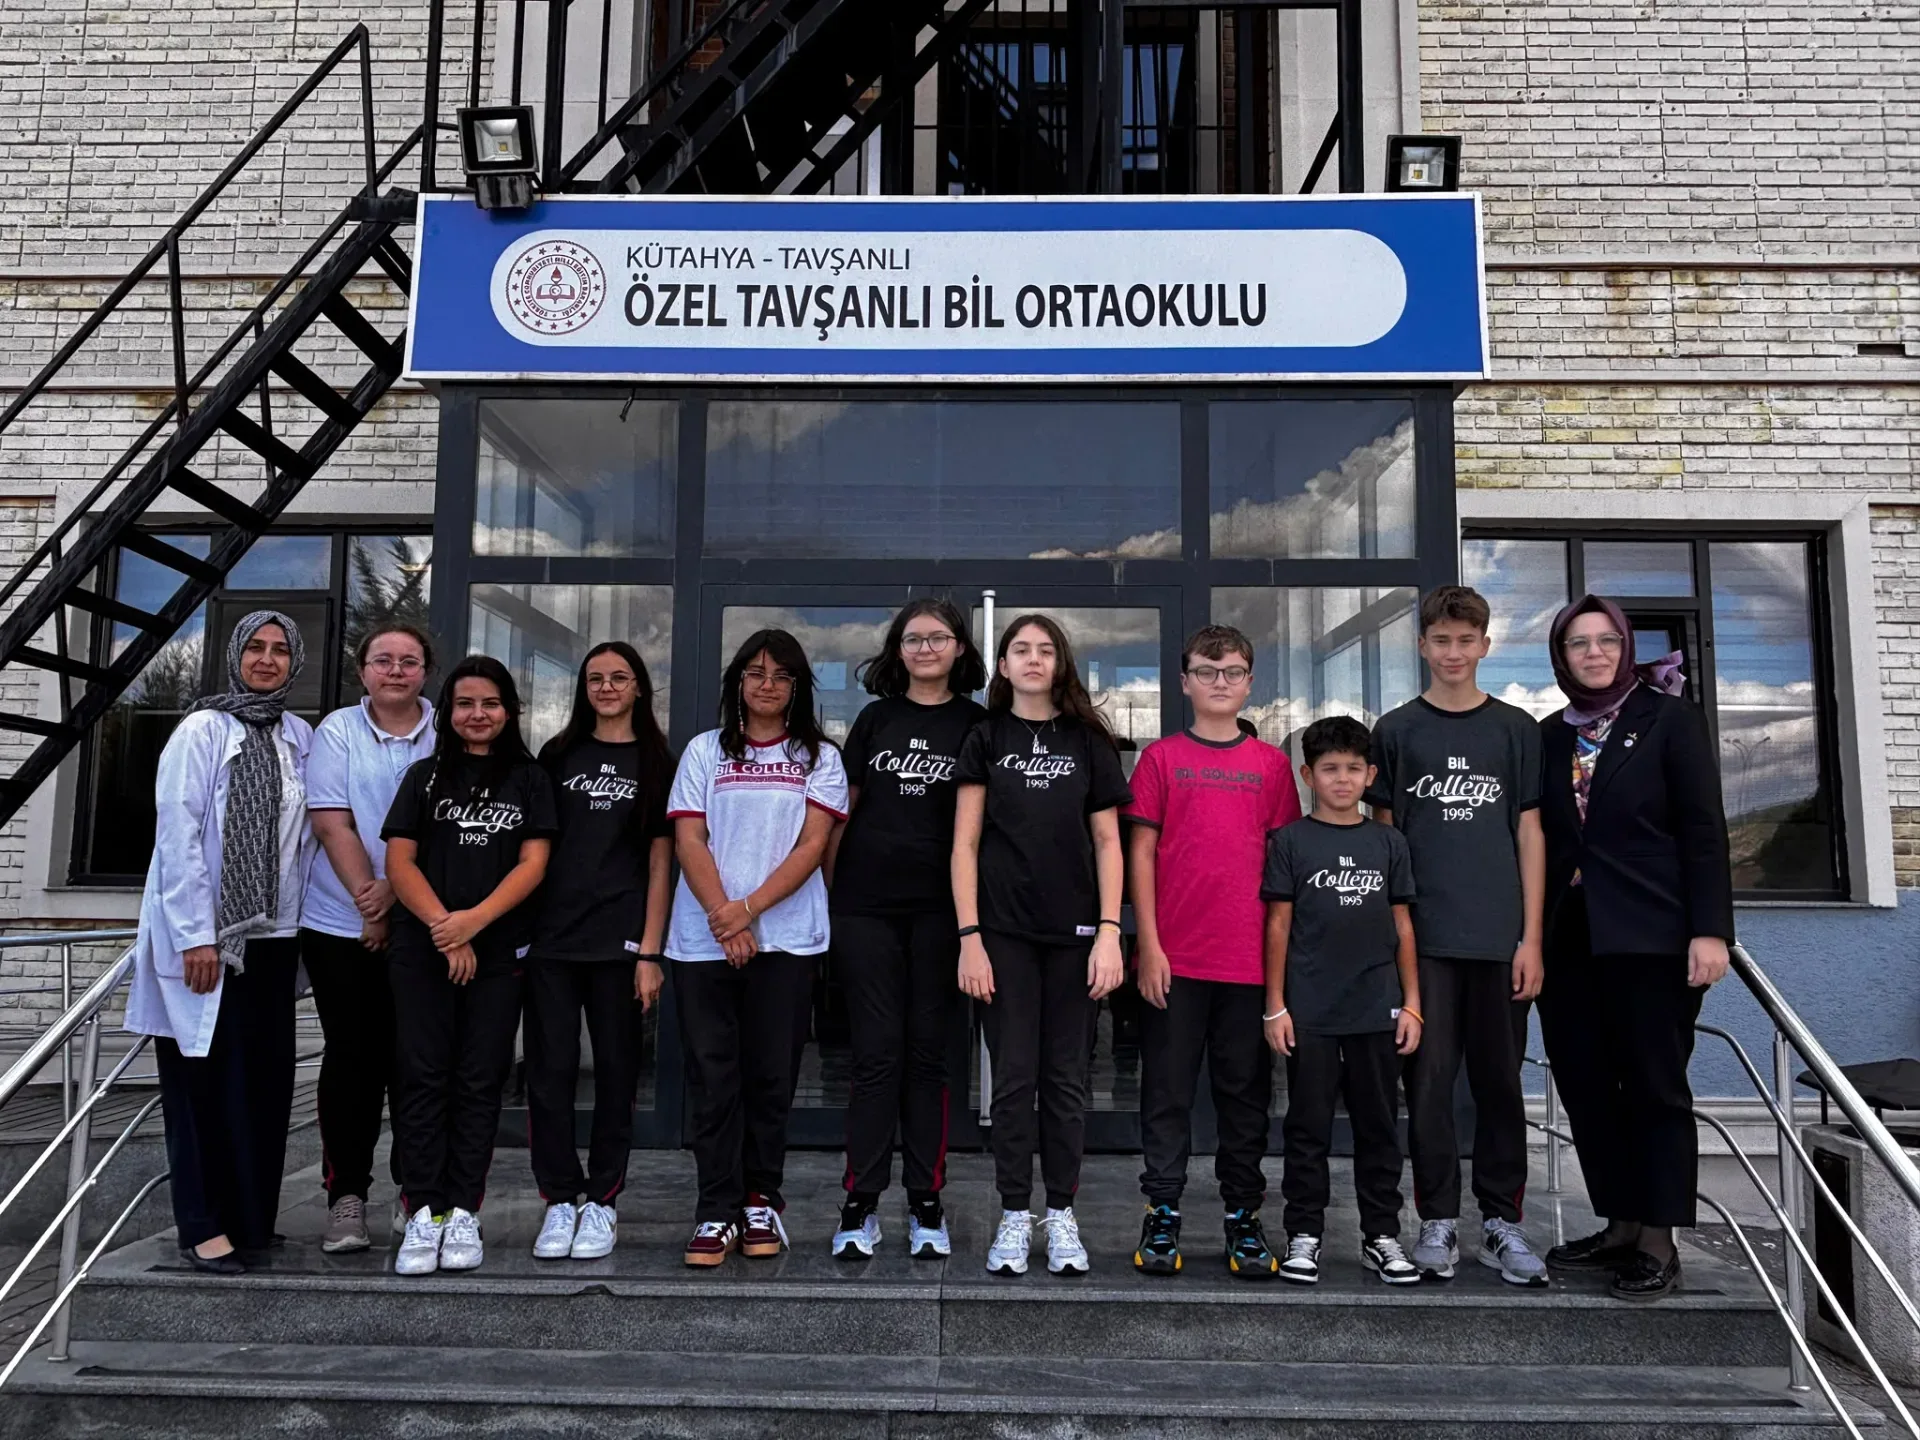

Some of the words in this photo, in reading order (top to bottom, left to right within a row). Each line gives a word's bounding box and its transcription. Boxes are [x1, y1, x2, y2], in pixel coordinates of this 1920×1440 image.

[626, 242, 755, 269] KÜTAHYA
[778, 247, 911, 276] TAVŞANLI
[624, 272, 728, 327] ÖZEL
[736, 284, 931, 341] TAVŞANLI
[944, 274, 1005, 328] BİL
[1015, 283, 1267, 328] ORTAOKULU
[741, 763, 801, 775] COLLEG
[996, 753, 1077, 779] College
[899, 783, 926, 796] 1995
[1025, 779, 1050, 789] 1995
[1406, 774, 1503, 807] College
[589, 800, 613, 811] 1995
[1442, 807, 1474, 821] 1995
[458, 832, 489, 846] 1995
[1306, 869, 1385, 895] College
[1339, 895, 1363, 906] 1995
